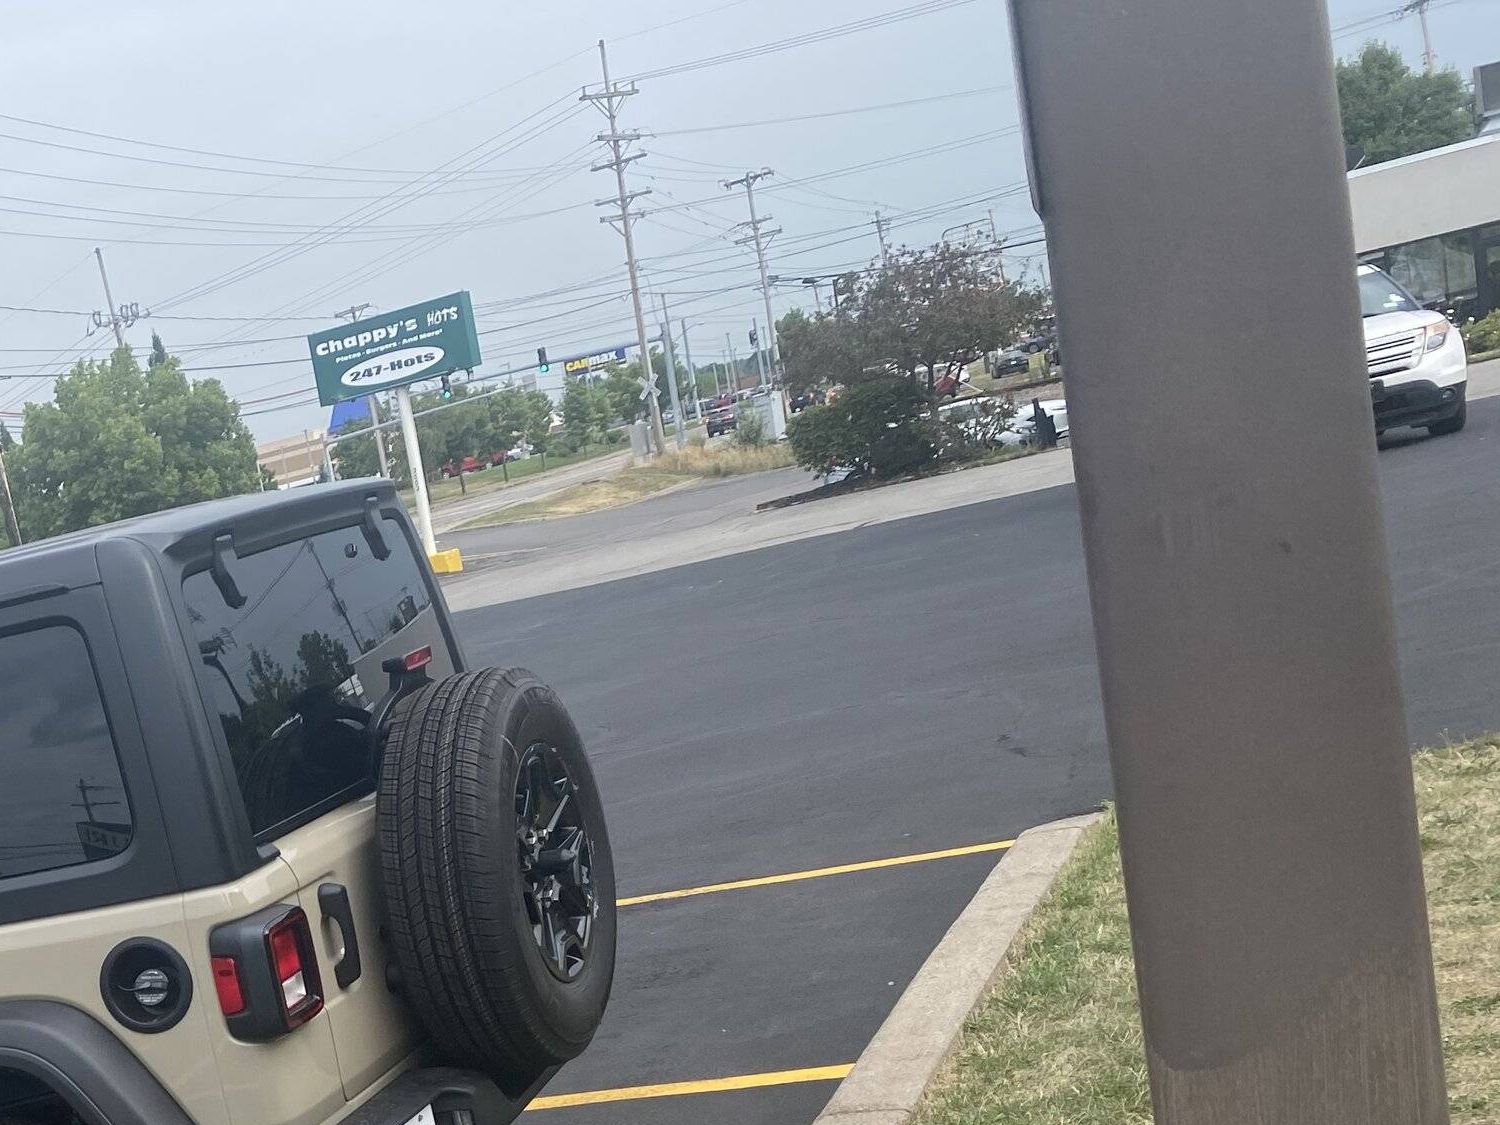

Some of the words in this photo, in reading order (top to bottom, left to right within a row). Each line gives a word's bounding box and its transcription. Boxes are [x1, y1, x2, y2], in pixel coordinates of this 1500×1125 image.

[316, 318, 418, 356] Chappy's
[426, 306, 458, 326] HOTS
[402, 335, 419, 344] And
[349, 350, 436, 382] 247-Hots
